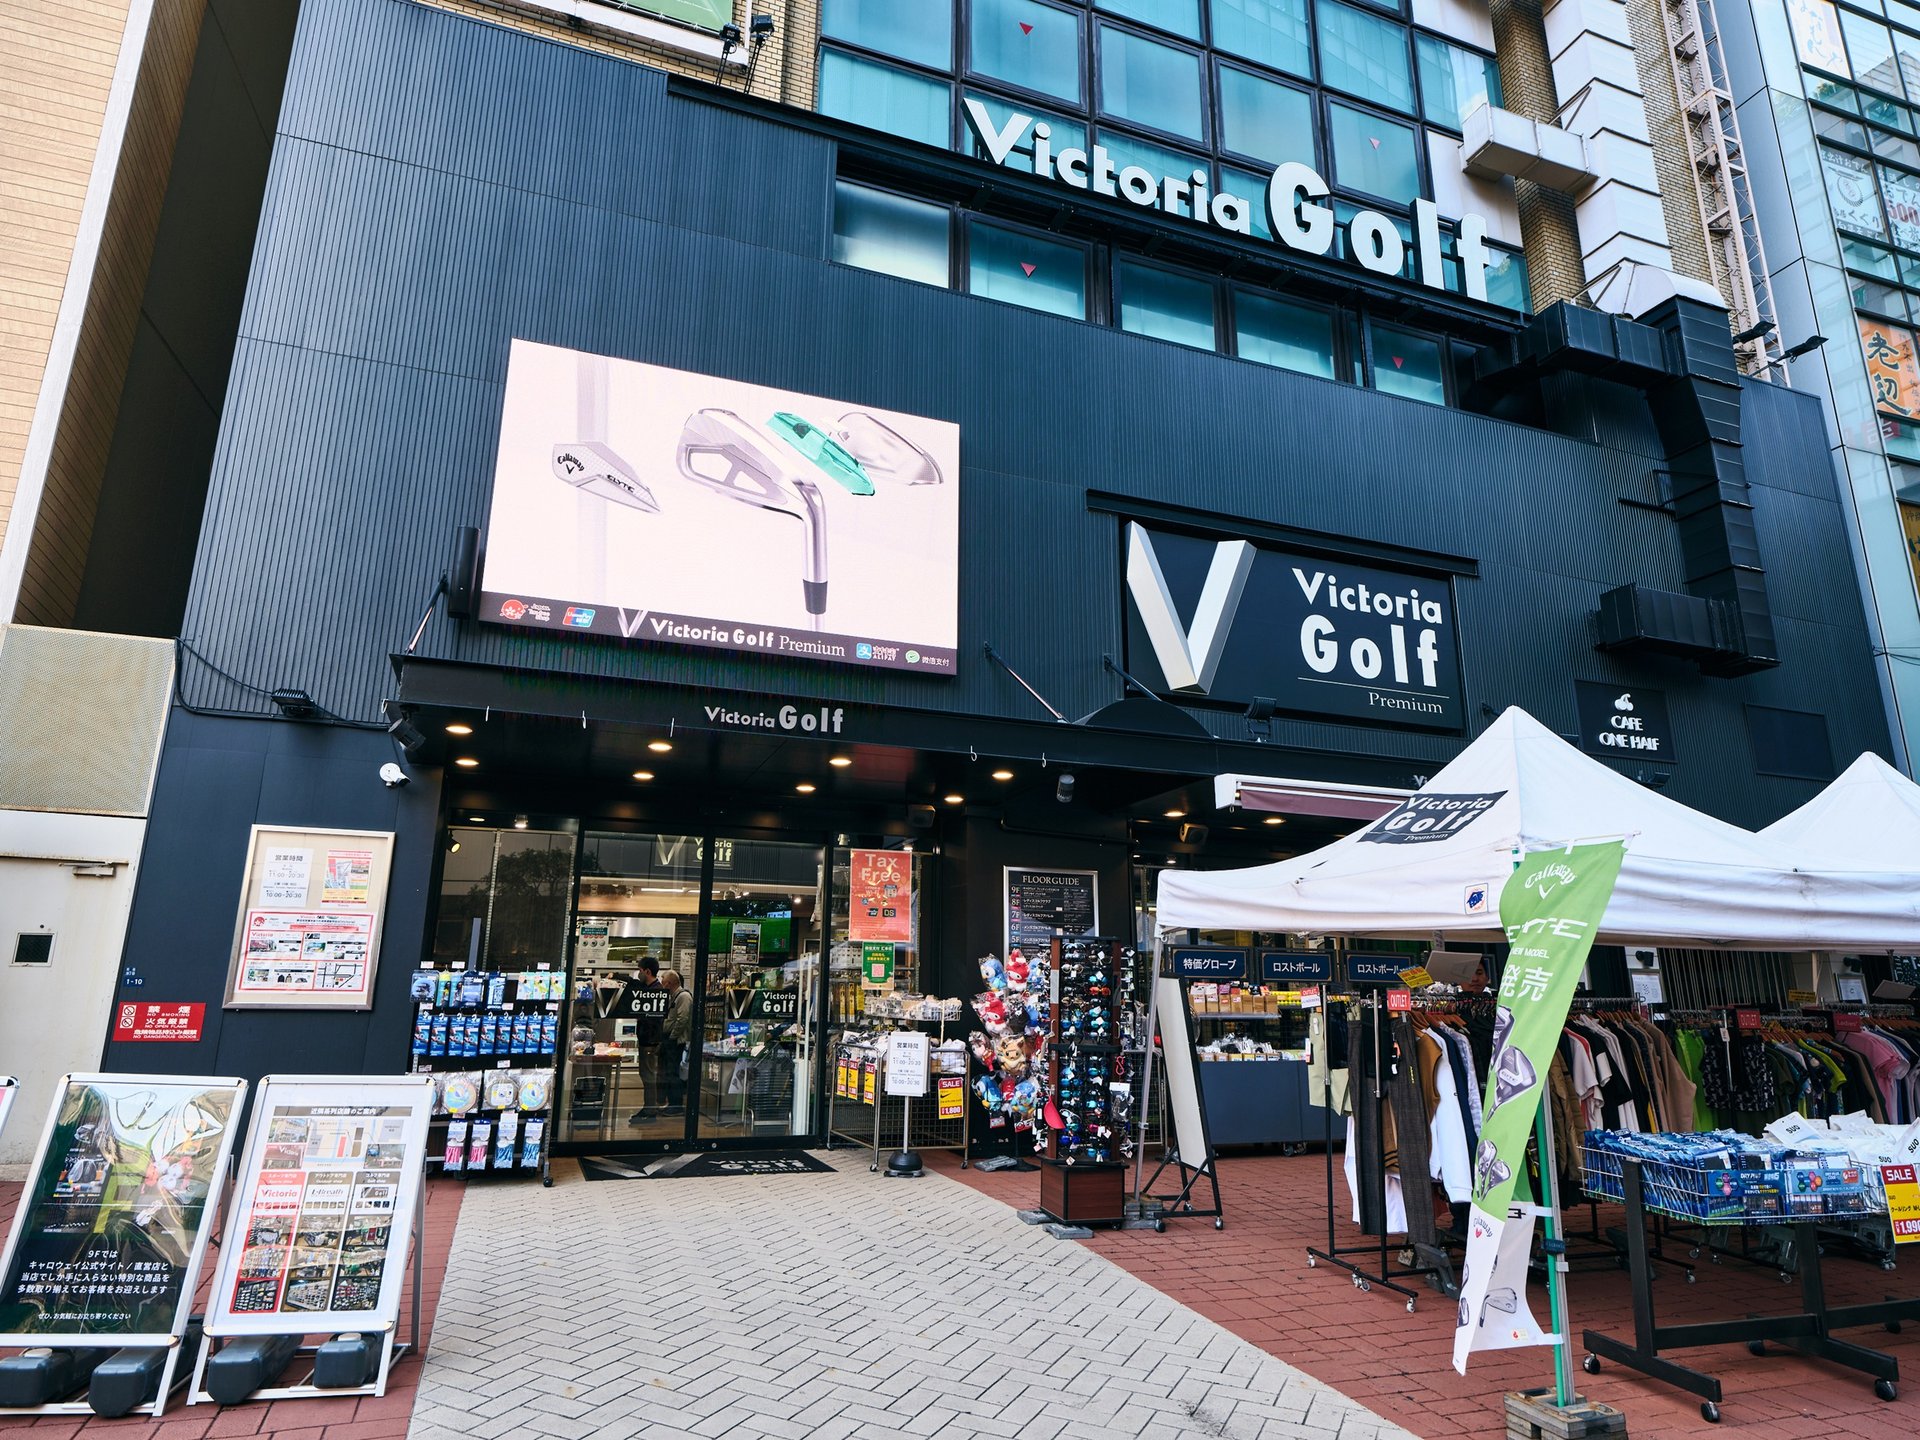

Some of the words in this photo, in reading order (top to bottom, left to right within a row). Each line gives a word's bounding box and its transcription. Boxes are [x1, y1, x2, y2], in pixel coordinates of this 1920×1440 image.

[962, 97, 1250, 235] Victoria
[1268, 161, 1502, 302] Golf
[557, 453, 585, 472] Callaway
[606, 474, 635, 493] ELYTE
[1291, 567, 1443, 625] Victoria
[650, 617, 729, 643] Victoria
[733, 628, 774, 648] Golf
[779, 635, 845, 657] Premium
[1300, 614, 1439, 688] Golf
[1368, 691, 1444, 715] Premium
[704, 705, 775, 728] Victoria
[778, 704, 844, 734] Golf
[1610, 715, 1644, 731] CAFE
[1598, 732, 1629, 748] ONE
[1629, 735, 1660, 751] HALF
[1406, 797, 1494, 810] Victoria
[1384, 810, 1482, 833] Golf
[695, 837, 732, 848] Voria
[1404, 833, 1449, 841] Premium
[696, 847, 732, 862] Glf
[865, 854, 898, 868] Tax
[861, 867, 901, 882] Free
[1524, 863, 1577, 889] Callaway
[1011, 886, 1020, 894] 9F
[1011, 898, 1020, 906] 8F
[1011, 910, 1020, 918] 7F
[1011, 923, 1020, 931] 6F
[1524, 948, 1550, 959] MODEL
[1183, 958, 1237, 970] 特価グローブ
[1273, 962, 1321, 973] ロストボール
[1499, 965, 1554, 1001] 発売
[631, 990, 668, 999] Victoria
[762, 991, 797, 1000] Victoria
[1302, 988, 1319, 996] OUTLET
[631, 999, 666, 1013] Golf
[762, 1000, 795, 1013] Golf
[1390, 994, 1408, 1008] OUTLET
[942, 1080, 961, 1088] SALE
[1785, 1124, 1801, 1134] SUO
[1908, 1138, 1920, 1154] SUO
[1886, 1169, 1913, 1181] SALE
[261, 1189, 298, 1198] Victoria
[88, 1250, 118, 1258] 9Fでは
[21, 1272, 169, 1283] 当店でしか手に入らない特別な商品を
[17, 1285, 167, 1295] 多数取り揃えてお客様をお迎えします
